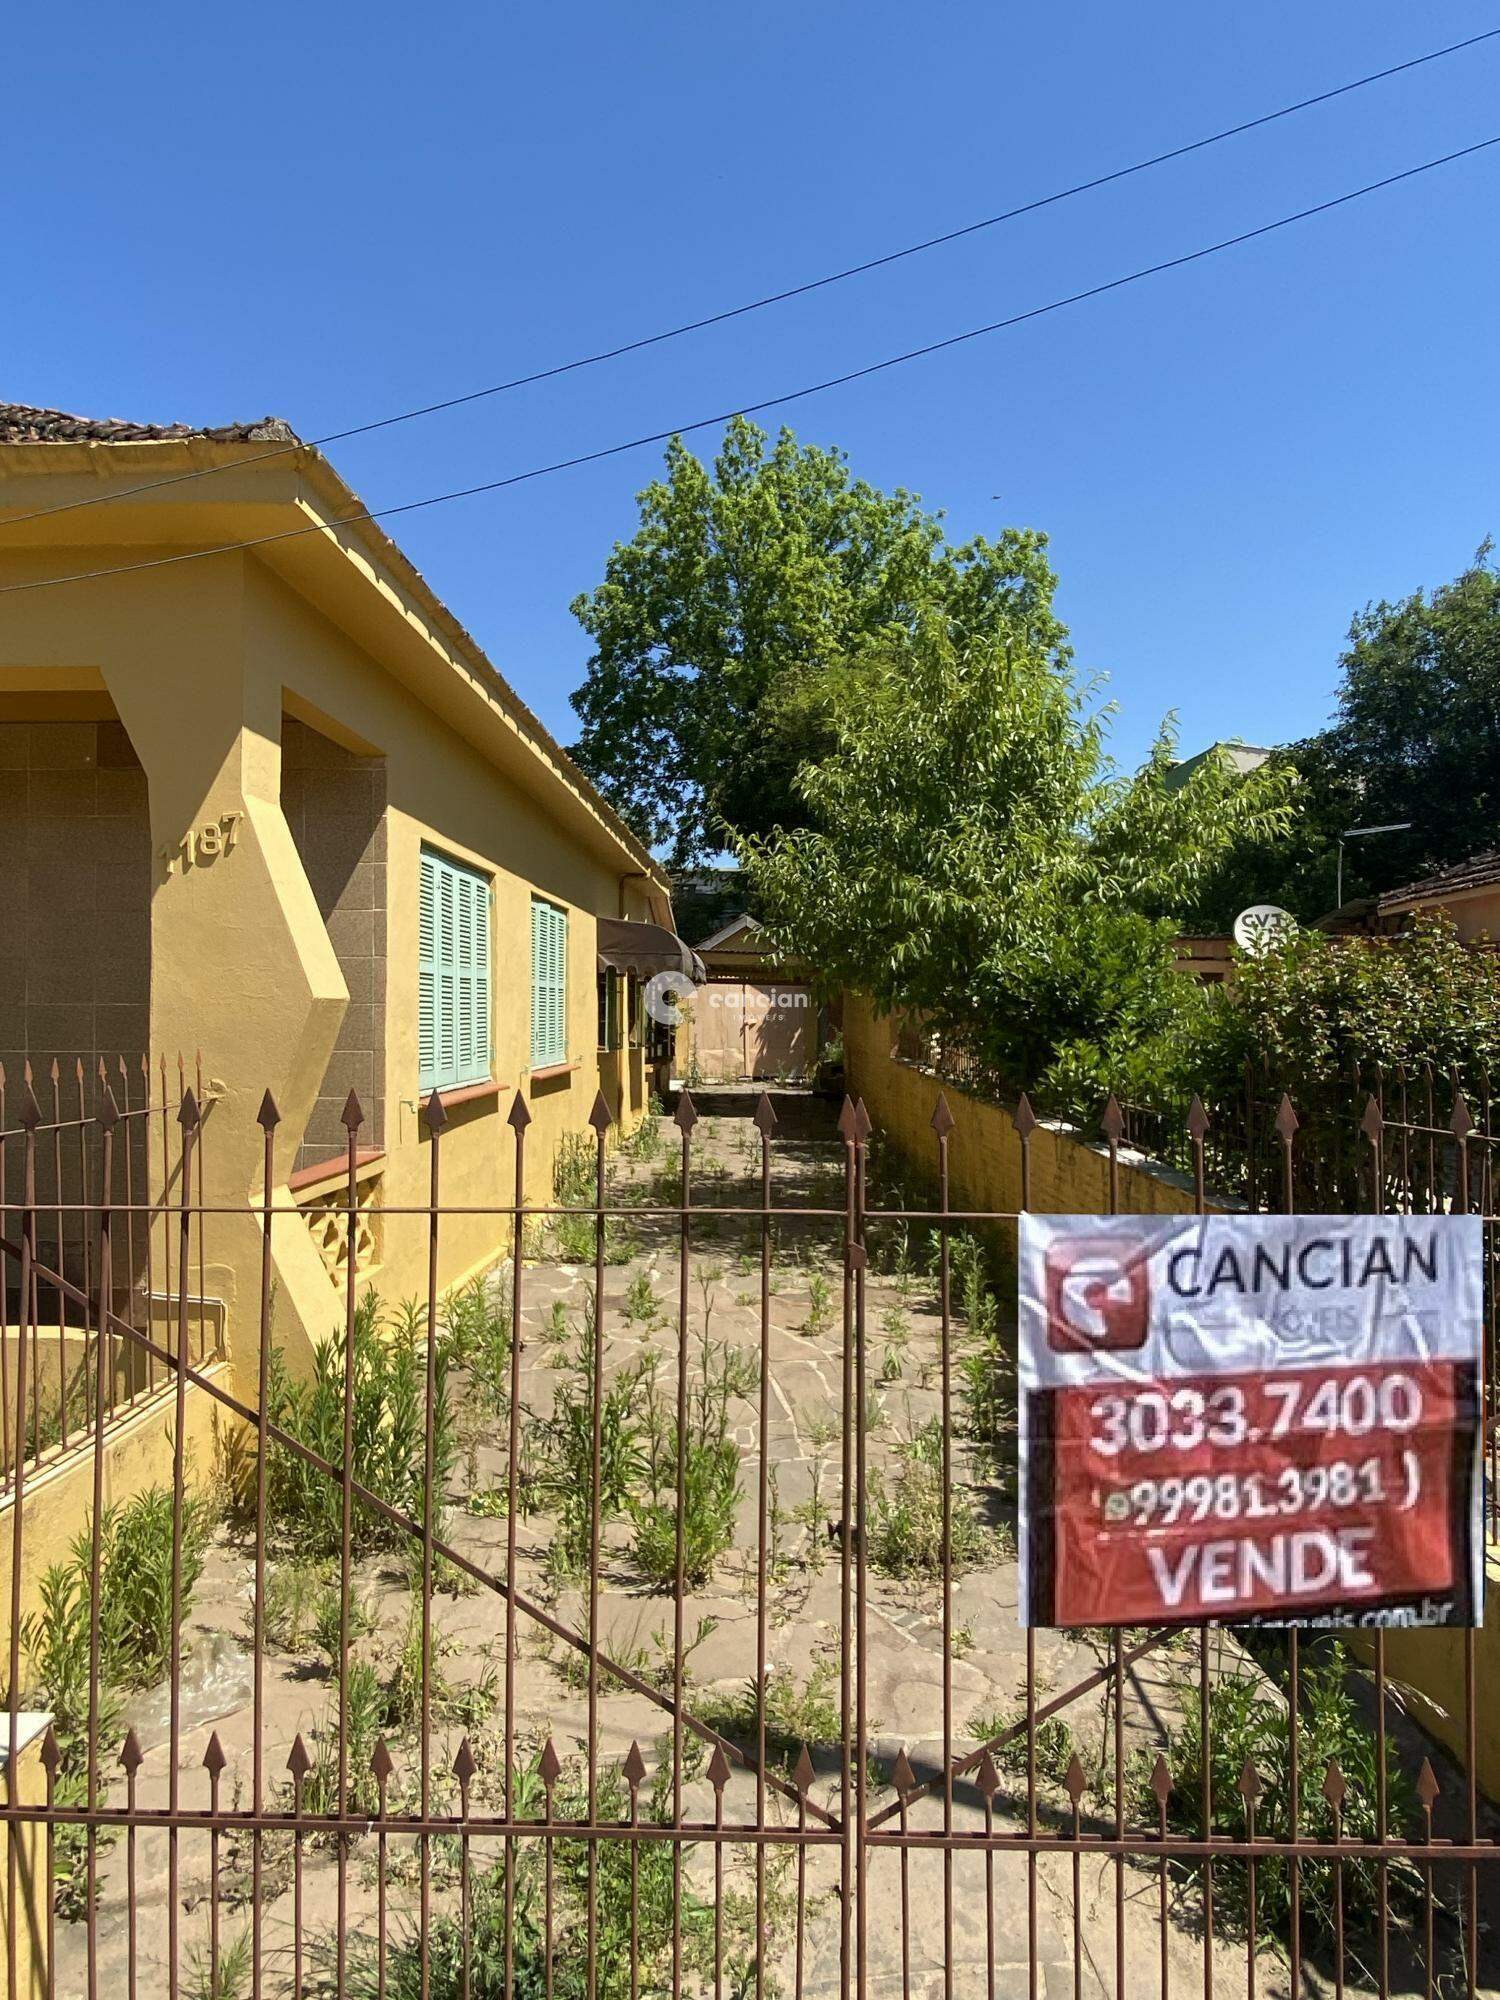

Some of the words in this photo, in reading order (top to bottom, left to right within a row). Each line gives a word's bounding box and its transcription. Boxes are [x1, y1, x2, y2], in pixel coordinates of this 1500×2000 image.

[157, 811, 245, 874] 1187
[1166, 1236, 1437, 1297] CANCIAN
[1090, 1374, 1424, 1456] 3033.7400
[1146, 1525, 1376, 1607] VENDE
